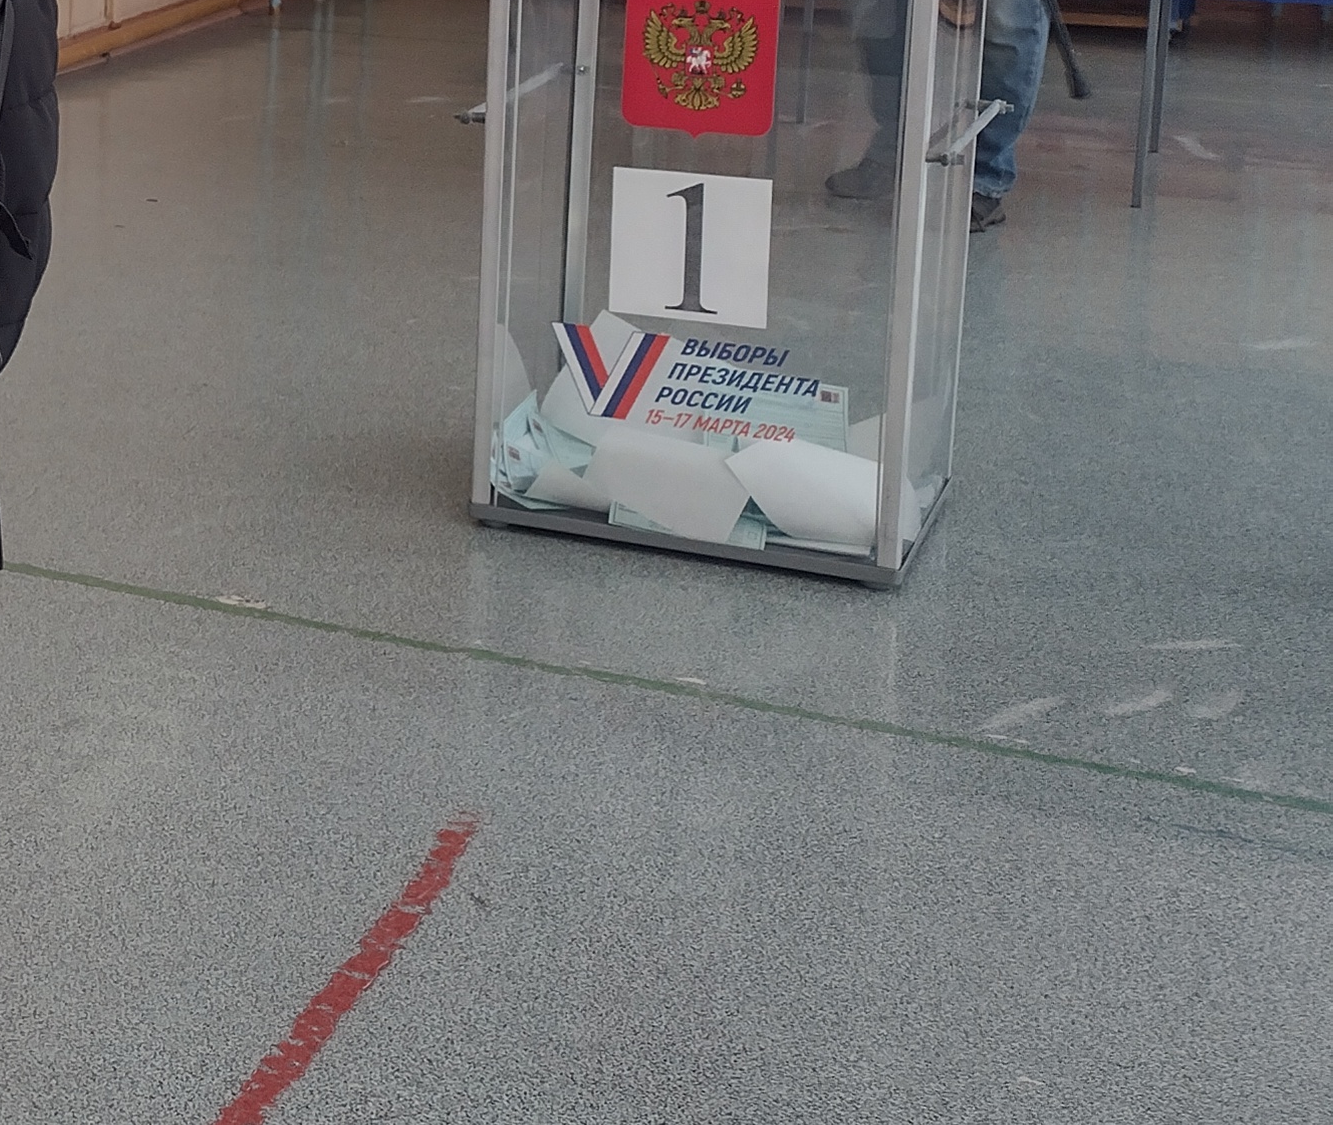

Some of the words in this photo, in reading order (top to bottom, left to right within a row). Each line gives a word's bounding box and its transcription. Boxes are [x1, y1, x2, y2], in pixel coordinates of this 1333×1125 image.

[664, 182, 718, 315] 1
[681, 338, 790, 367] ВЫБОРЫ
[667, 362, 821, 397] ПРЕЗИДЕНТА
[655, 386, 753, 415] РОССИИ
[692, 415, 751, 438] МАРТА
[752, 424, 796, 443] 2024
